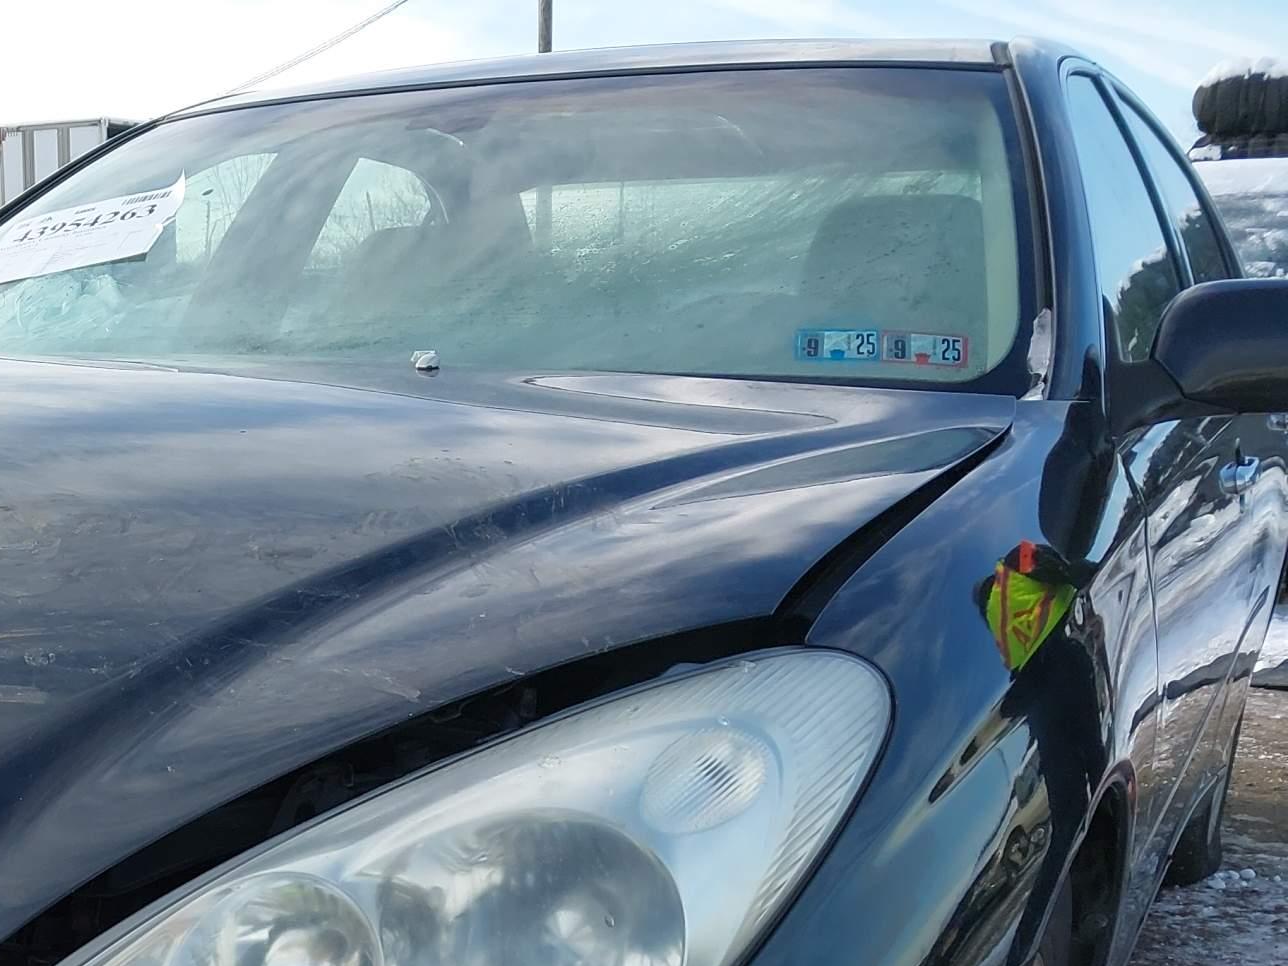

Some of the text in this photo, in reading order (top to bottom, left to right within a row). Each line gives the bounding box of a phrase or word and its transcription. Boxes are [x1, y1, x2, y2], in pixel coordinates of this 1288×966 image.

[12, 203, 158, 243] 43954263
[855, 332, 876, 356] 25
[941, 338, 961, 362] 25
